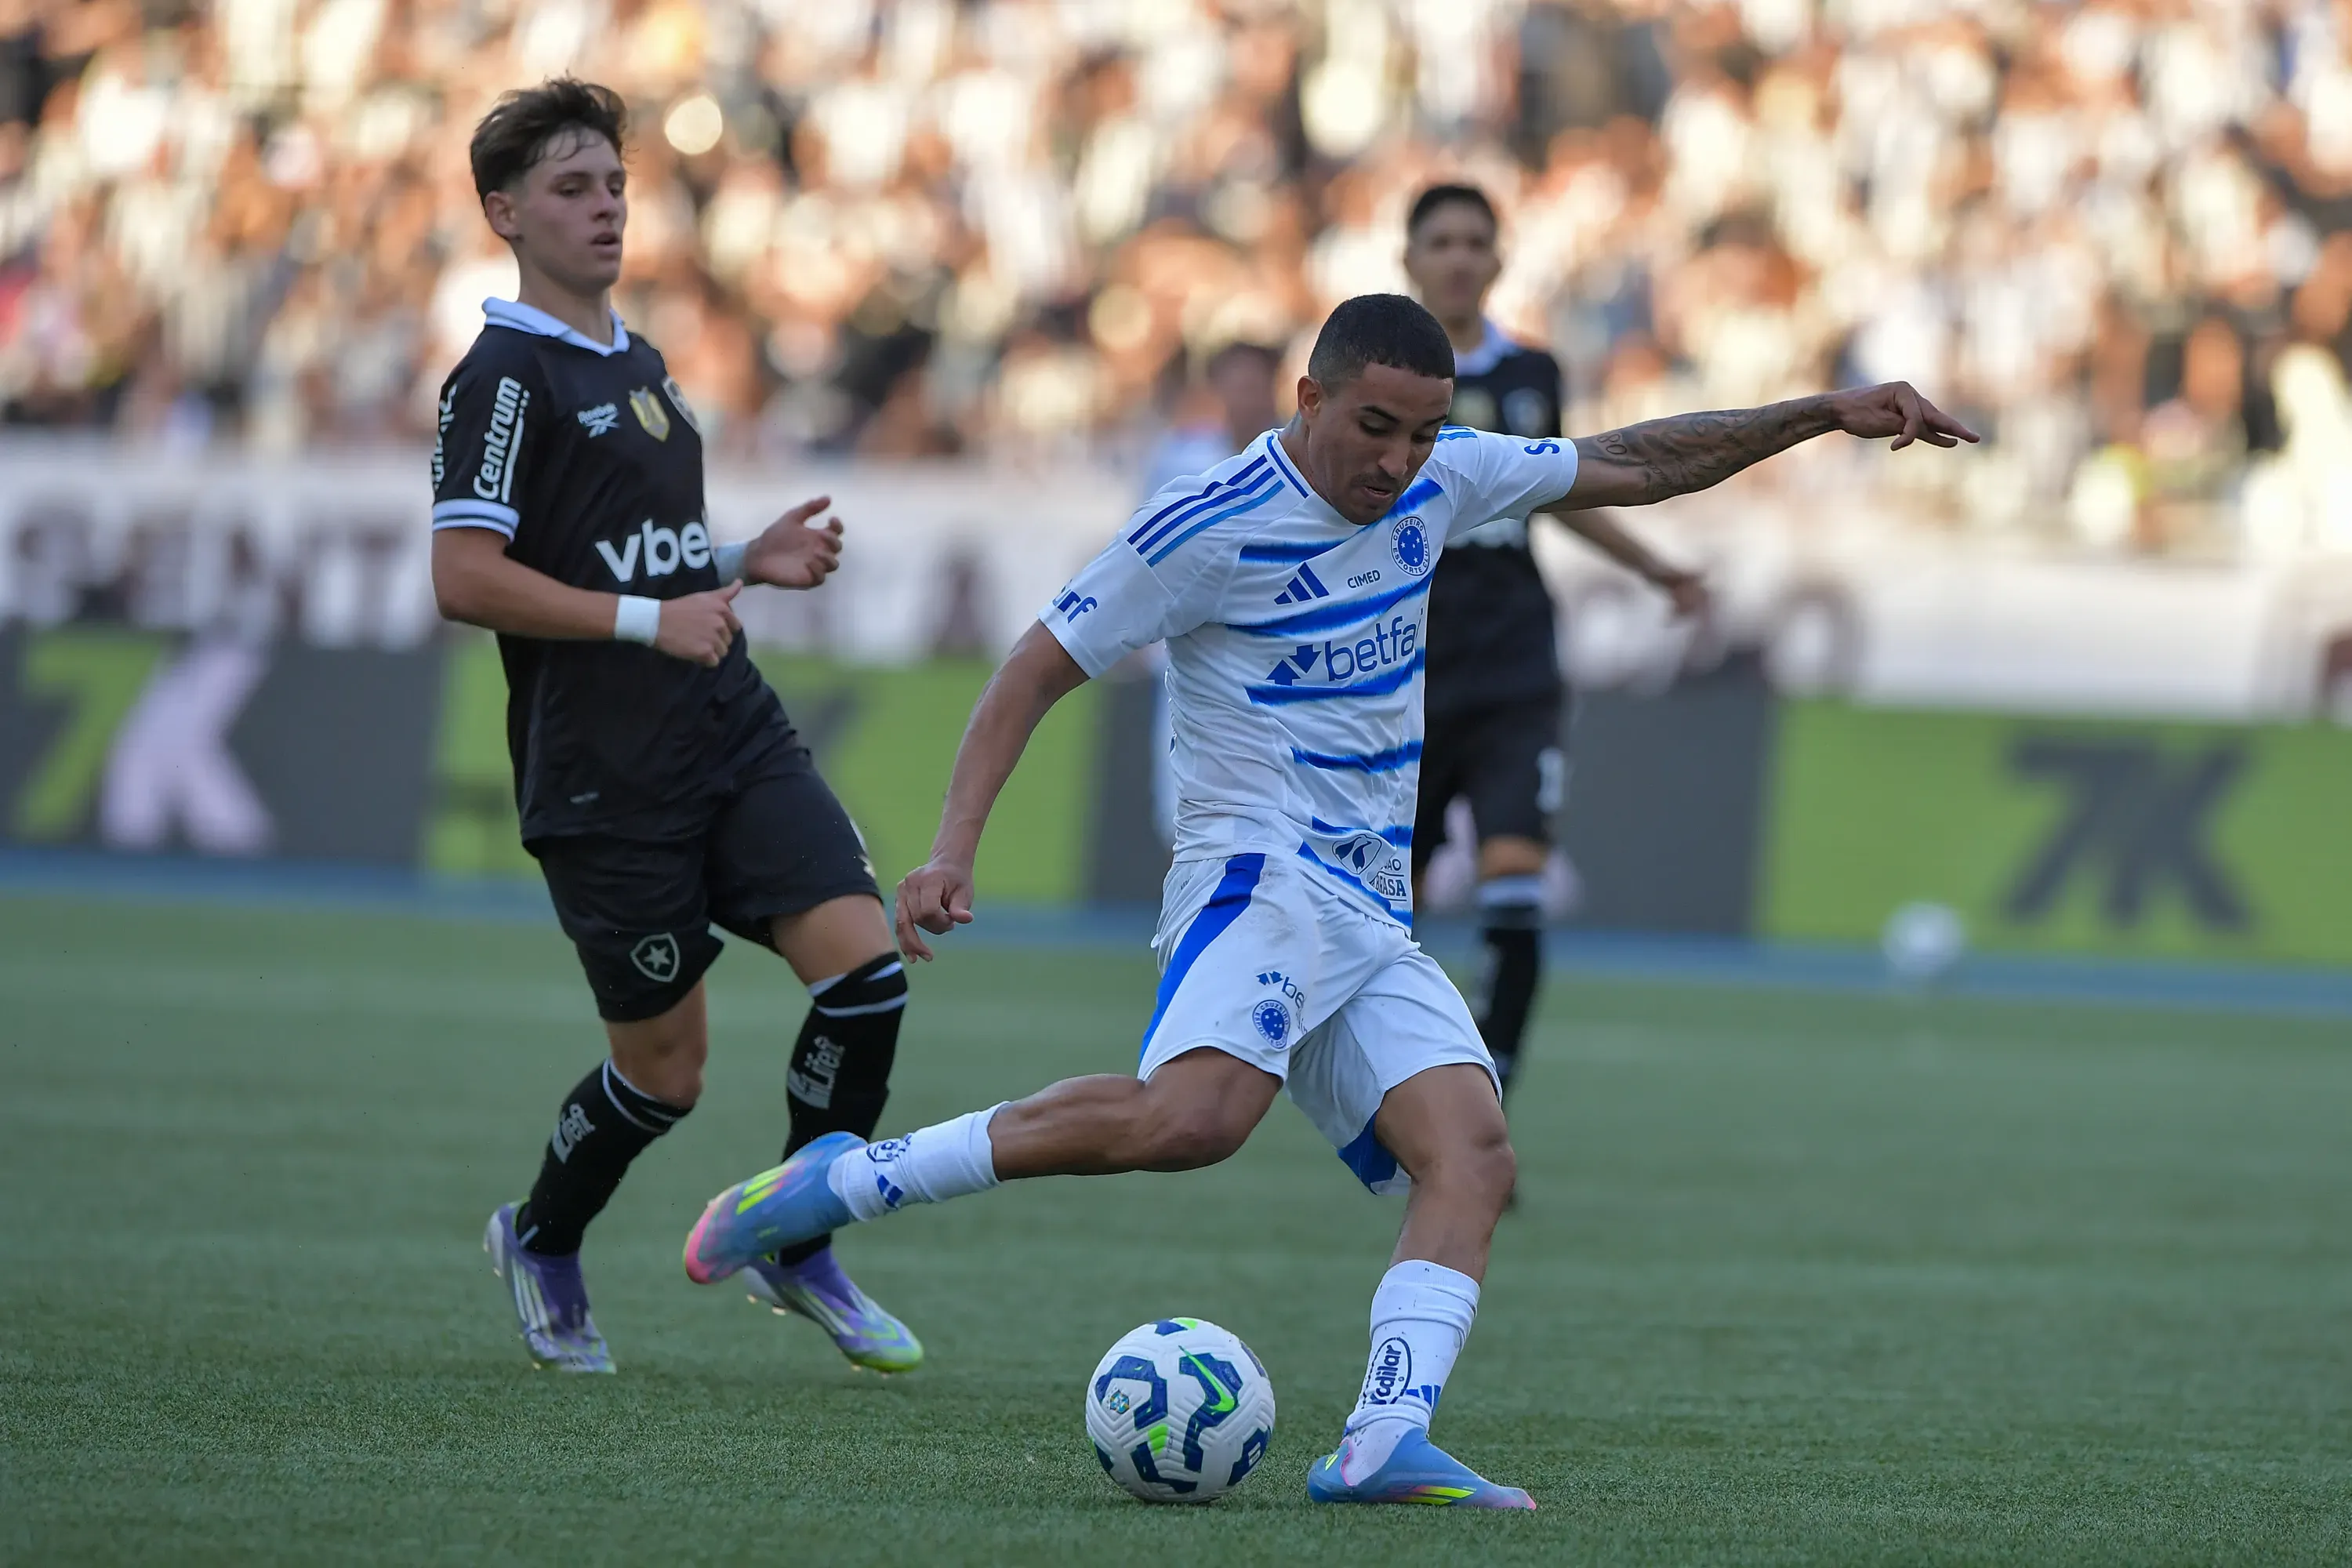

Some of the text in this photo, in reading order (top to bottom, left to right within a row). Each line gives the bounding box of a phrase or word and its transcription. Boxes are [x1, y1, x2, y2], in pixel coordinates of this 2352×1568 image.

[473, 376, 522, 500] Centrum
[594, 517, 711, 583] vbe
[1392, 518, 1424, 541] CRUZEIRO
[1347, 569, 1381, 589] CIMED
[1392, 547, 1423, 574] ESPORTE
[2005, 734, 2255, 931] 7K
